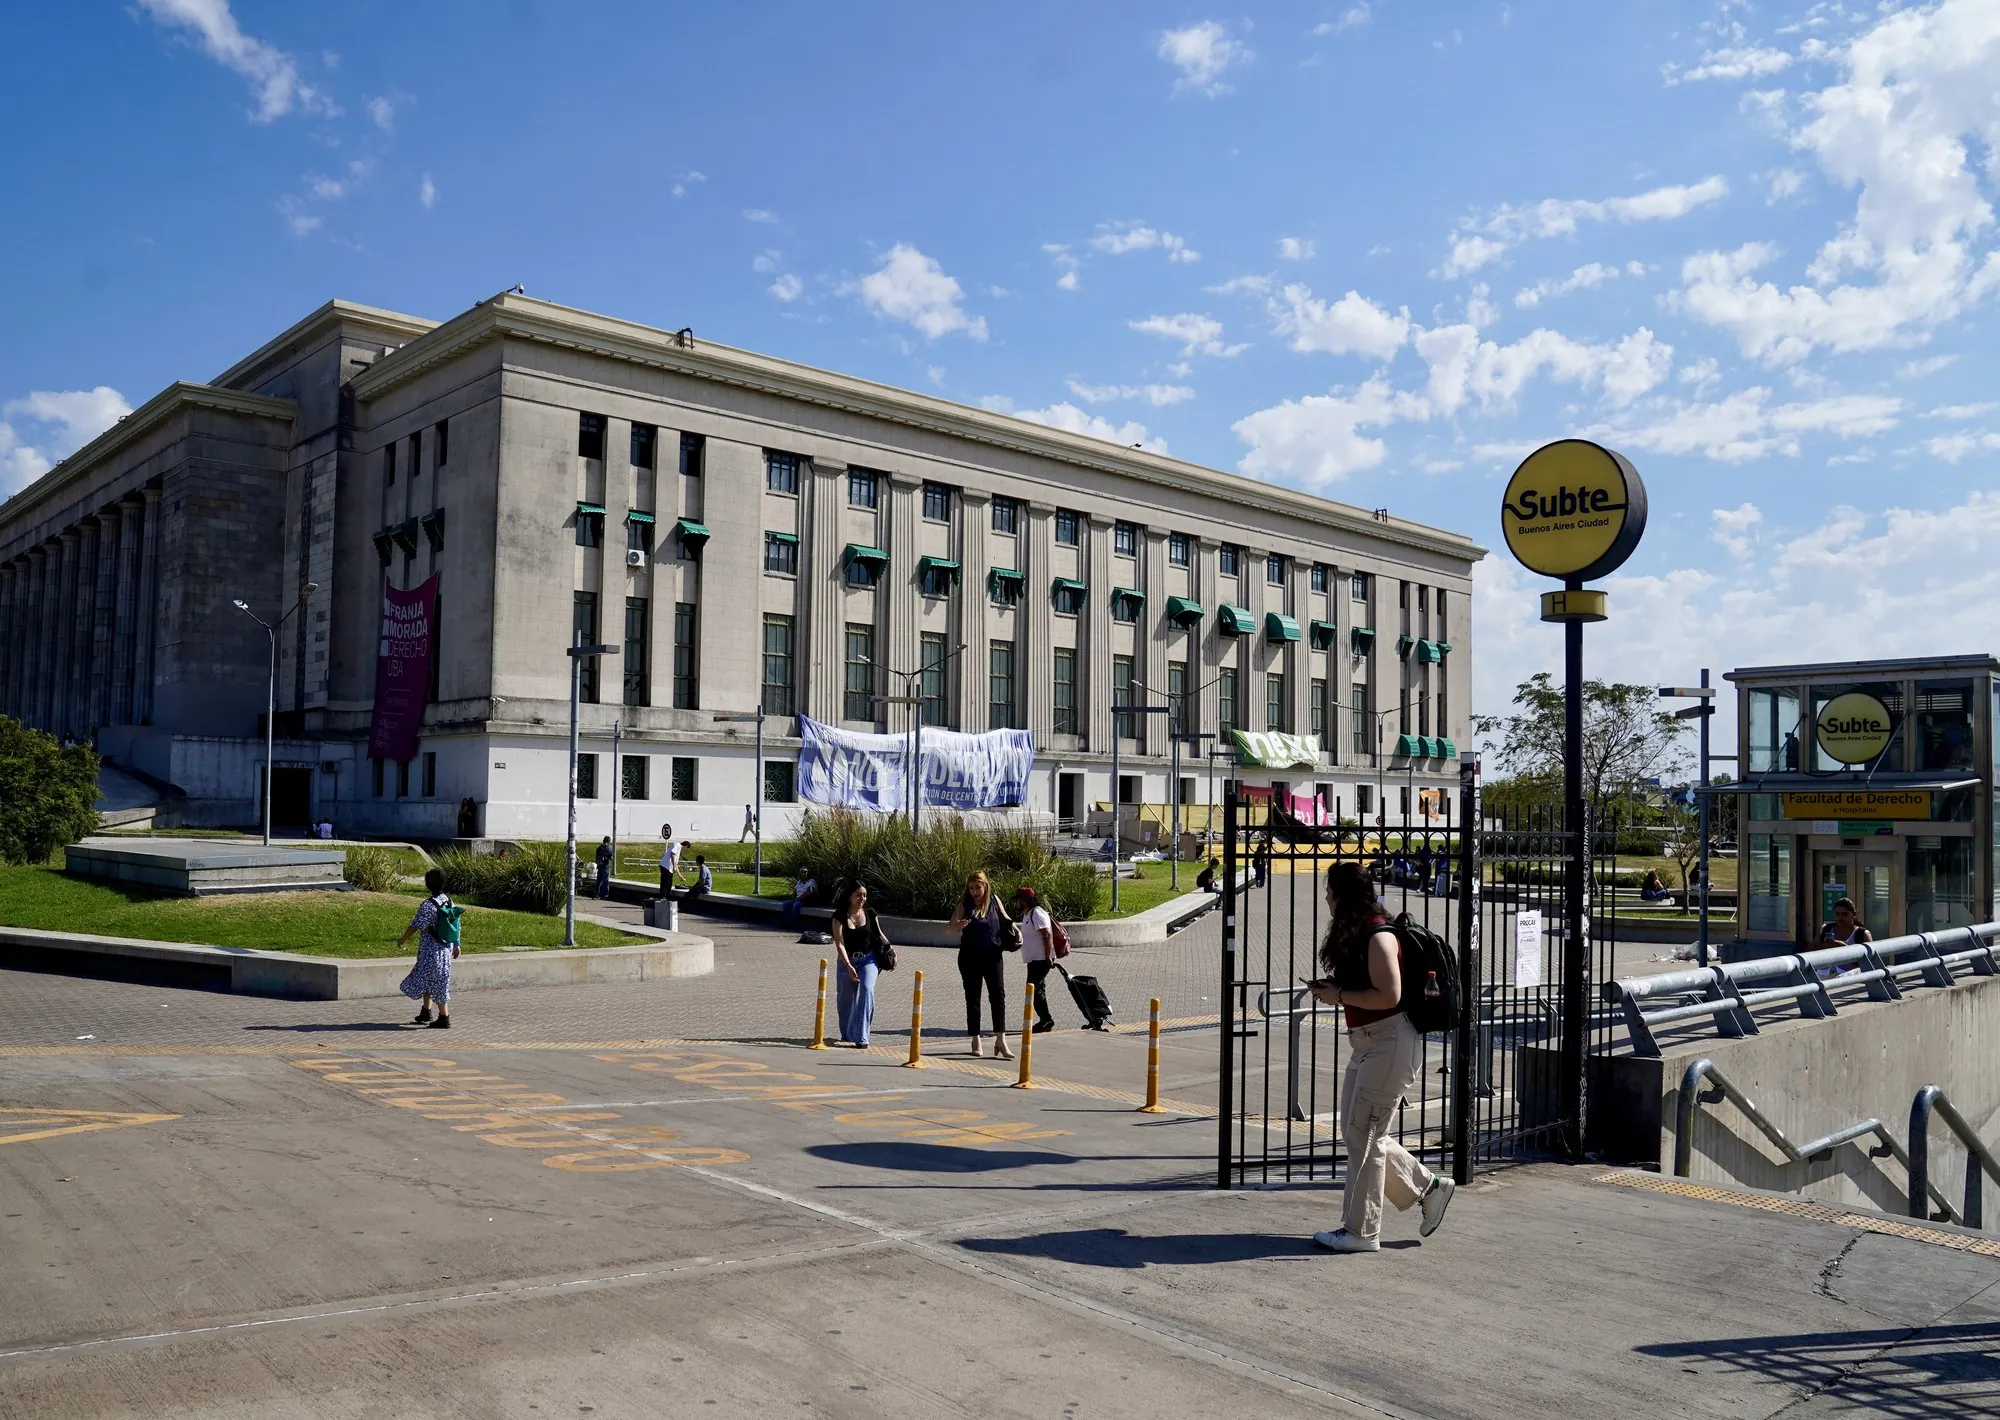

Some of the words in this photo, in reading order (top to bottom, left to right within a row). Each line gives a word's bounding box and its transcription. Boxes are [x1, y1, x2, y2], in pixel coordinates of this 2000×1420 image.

[1517, 486, 1613, 520] Subte
[1518, 525, 1551, 535] Buenos
[1553, 521, 1575, 531] Aires
[1577, 517, 1610, 529] Ciudad
[391, 601, 424, 620] FRANJA
[1552, 593, 1566, 613] H
[390, 618, 427, 639] MORADA
[389, 639, 427, 658] DERECHO
[388, 660, 404, 677] UBA
[1826, 717, 1884, 734] Subte
[1788, 792, 1842, 804] Facultad
[1846, 792, 1863, 804] de
[1867, 793, 1923, 804] Derecho
[1839, 806, 1877, 814] Hospitales
[289, 1056, 752, 1172] CUIDADO
